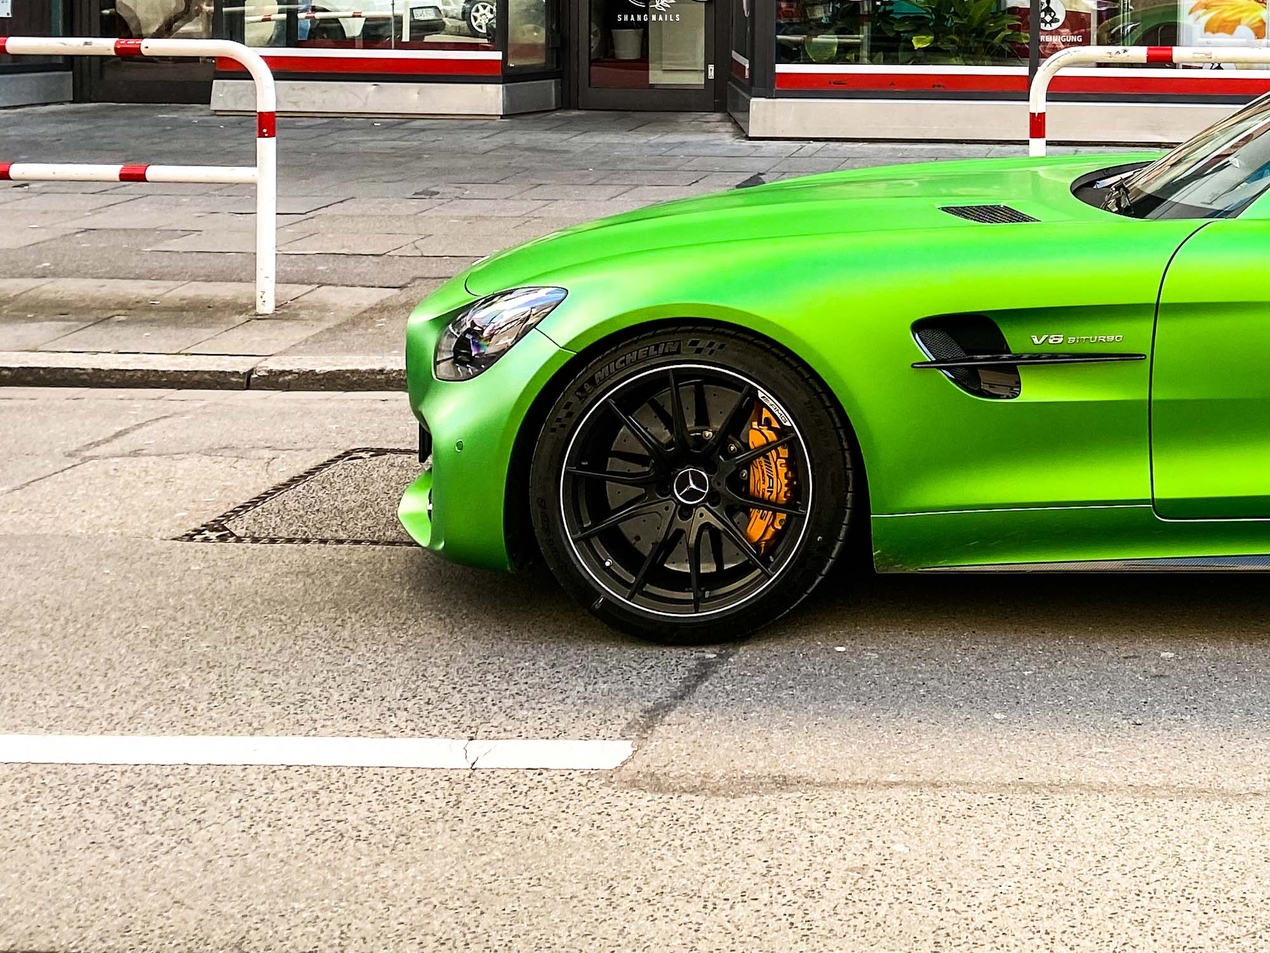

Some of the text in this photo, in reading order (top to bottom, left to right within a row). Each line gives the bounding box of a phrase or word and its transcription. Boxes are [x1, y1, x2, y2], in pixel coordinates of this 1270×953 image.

[617, 14, 681, 22] SHANG NAILS
[1040, 34, 1083, 43] REINIGUNG
[1067, 334, 1124, 345] BITURBO
[594, 341, 680, 385] MICHELIN
